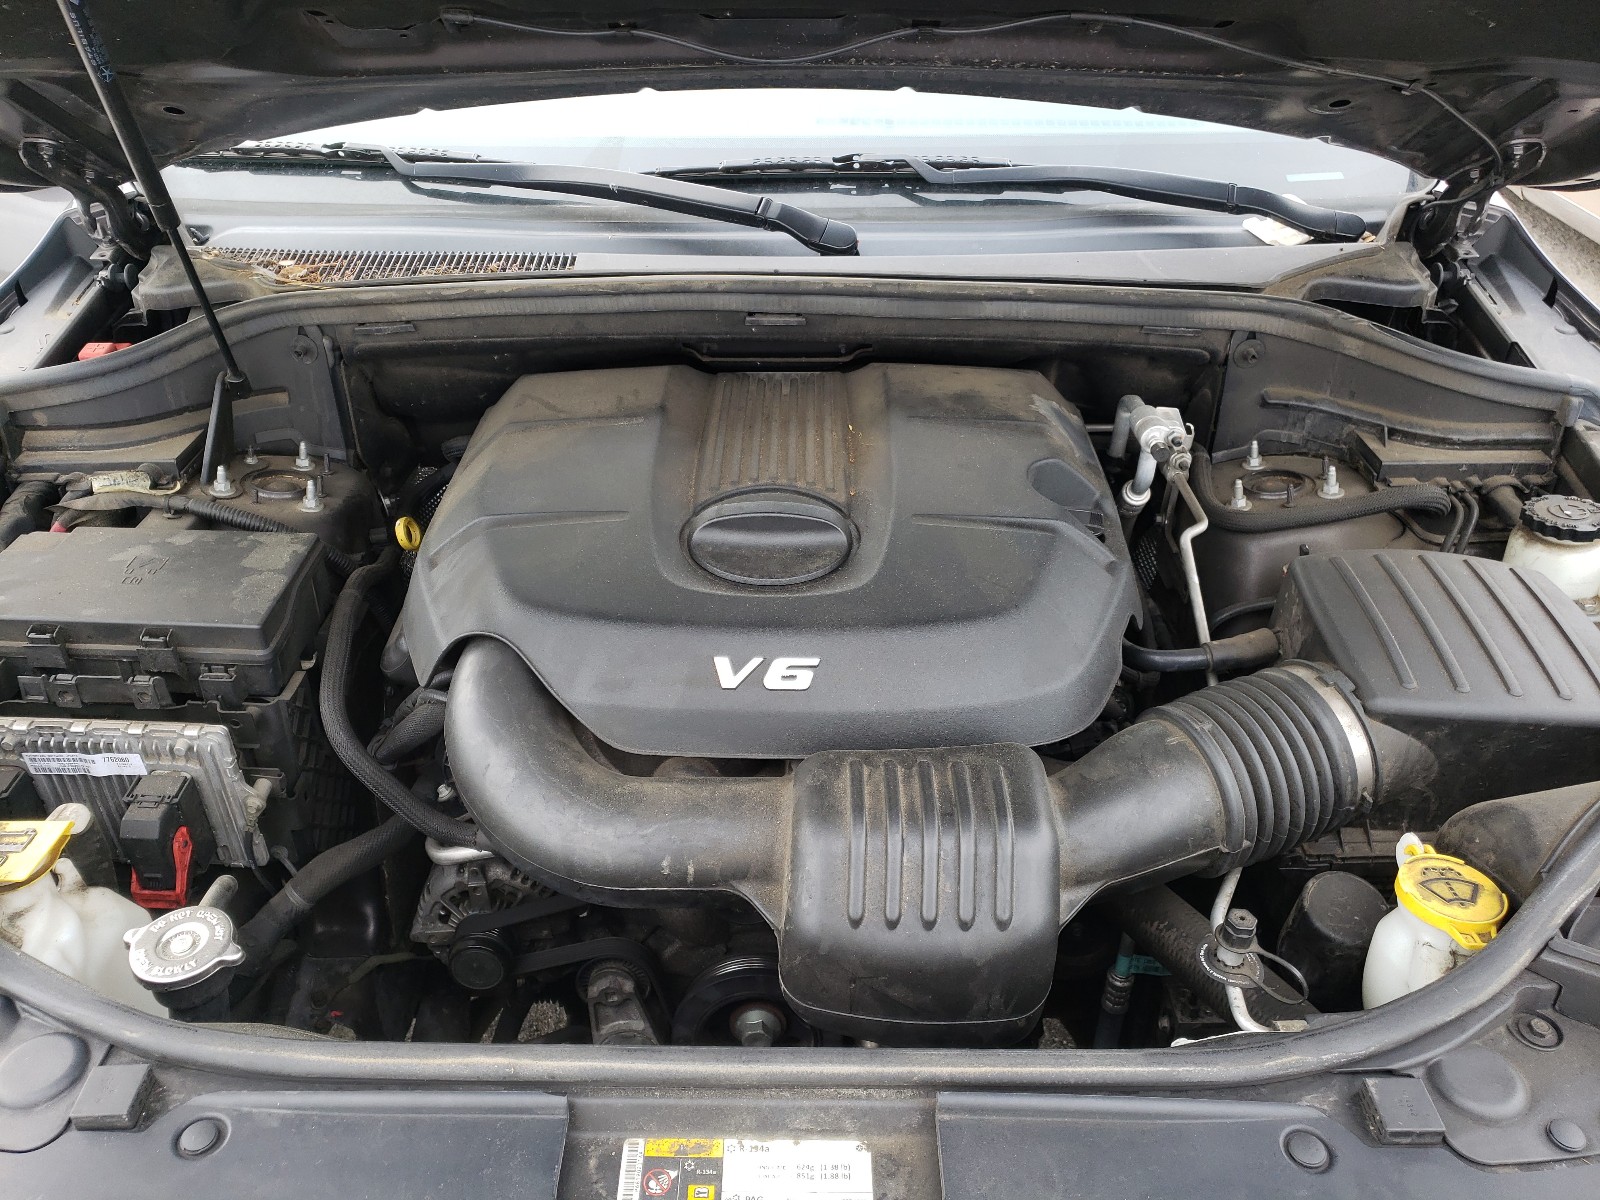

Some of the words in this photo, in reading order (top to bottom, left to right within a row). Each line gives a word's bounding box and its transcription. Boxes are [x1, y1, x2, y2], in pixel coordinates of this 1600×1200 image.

[714, 656, 821, 691] V6
[149, 919, 168, 933] DO
[169, 910, 192, 923] NOT
[196, 910, 219, 927] OPEN
[151, 958, 199, 977] SLOWLY
[796, 1172, 815, 1181] 851g
